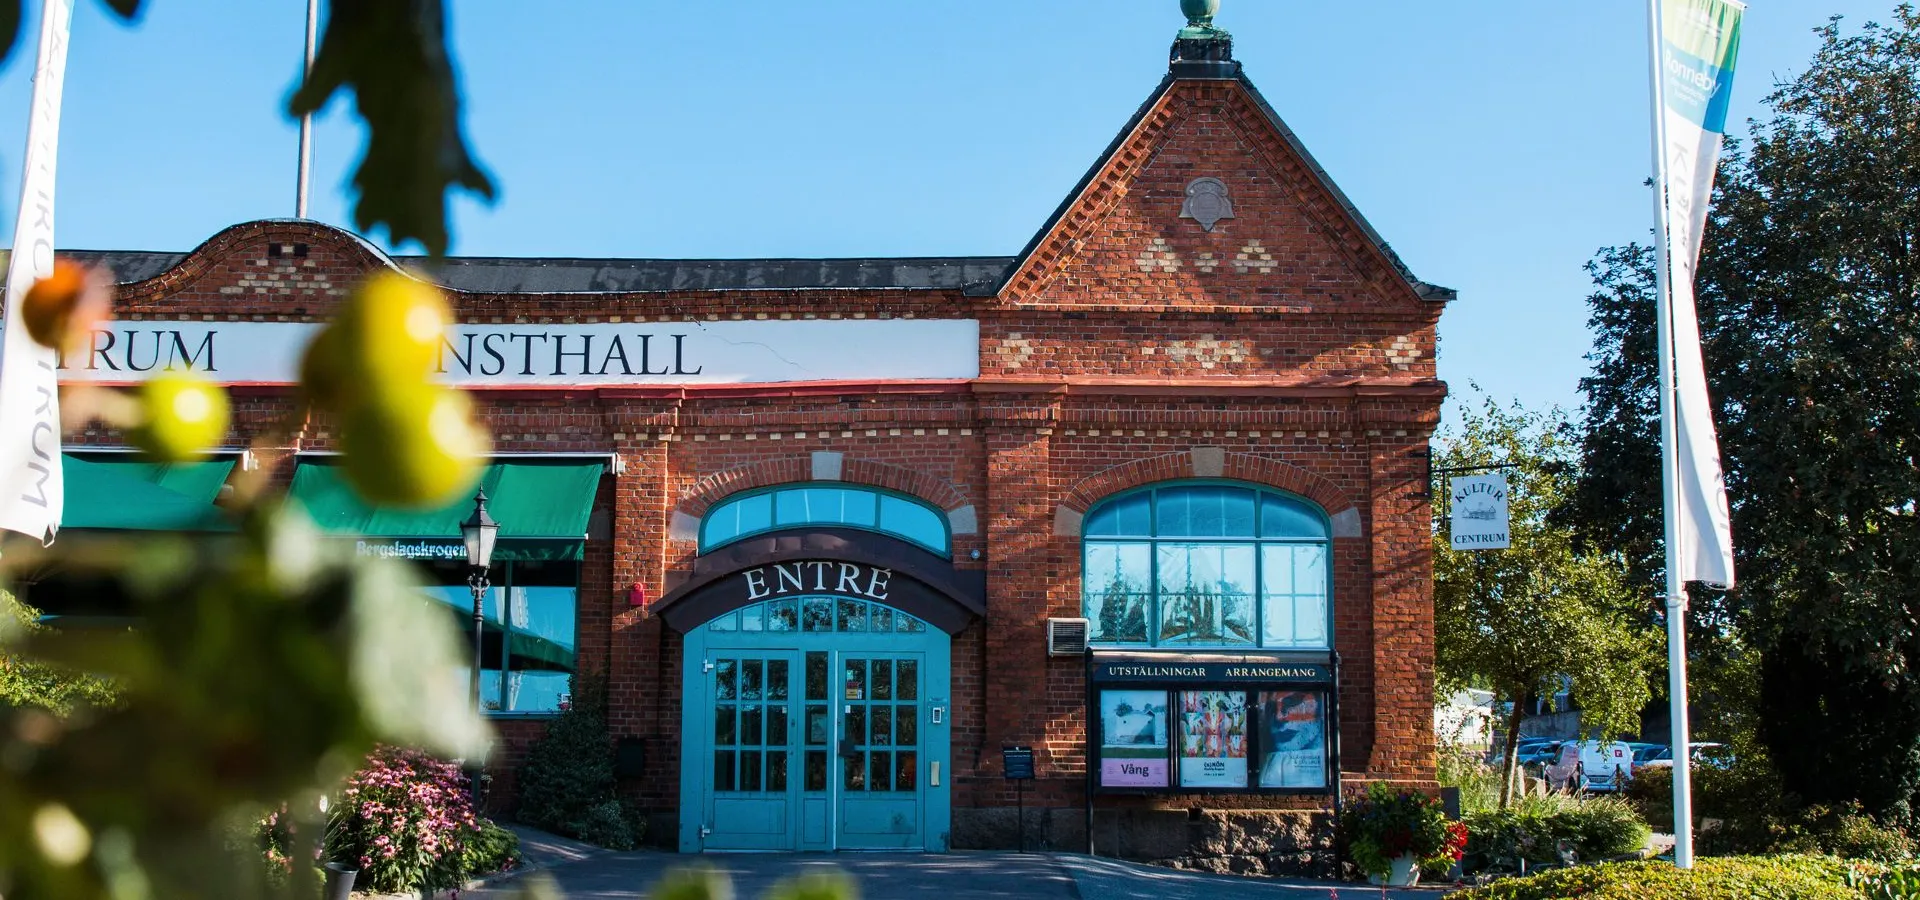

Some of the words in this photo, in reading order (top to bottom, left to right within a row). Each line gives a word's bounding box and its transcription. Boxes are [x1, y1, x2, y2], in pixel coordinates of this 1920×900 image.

[434, 331, 703, 376] NSTHALL
[1455, 482, 1504, 503] KULTUR
[1454, 533, 1505, 544] CENTRUM
[356, 540, 467, 559] Bergslagskrogen
[742, 561, 892, 600] ENTRÉ
[1109, 665, 1206, 677] UTSTÄLLNINGAR
[1225, 667, 1316, 677] ARRANGEMANG
[1121, 763, 1149, 777] Vång
